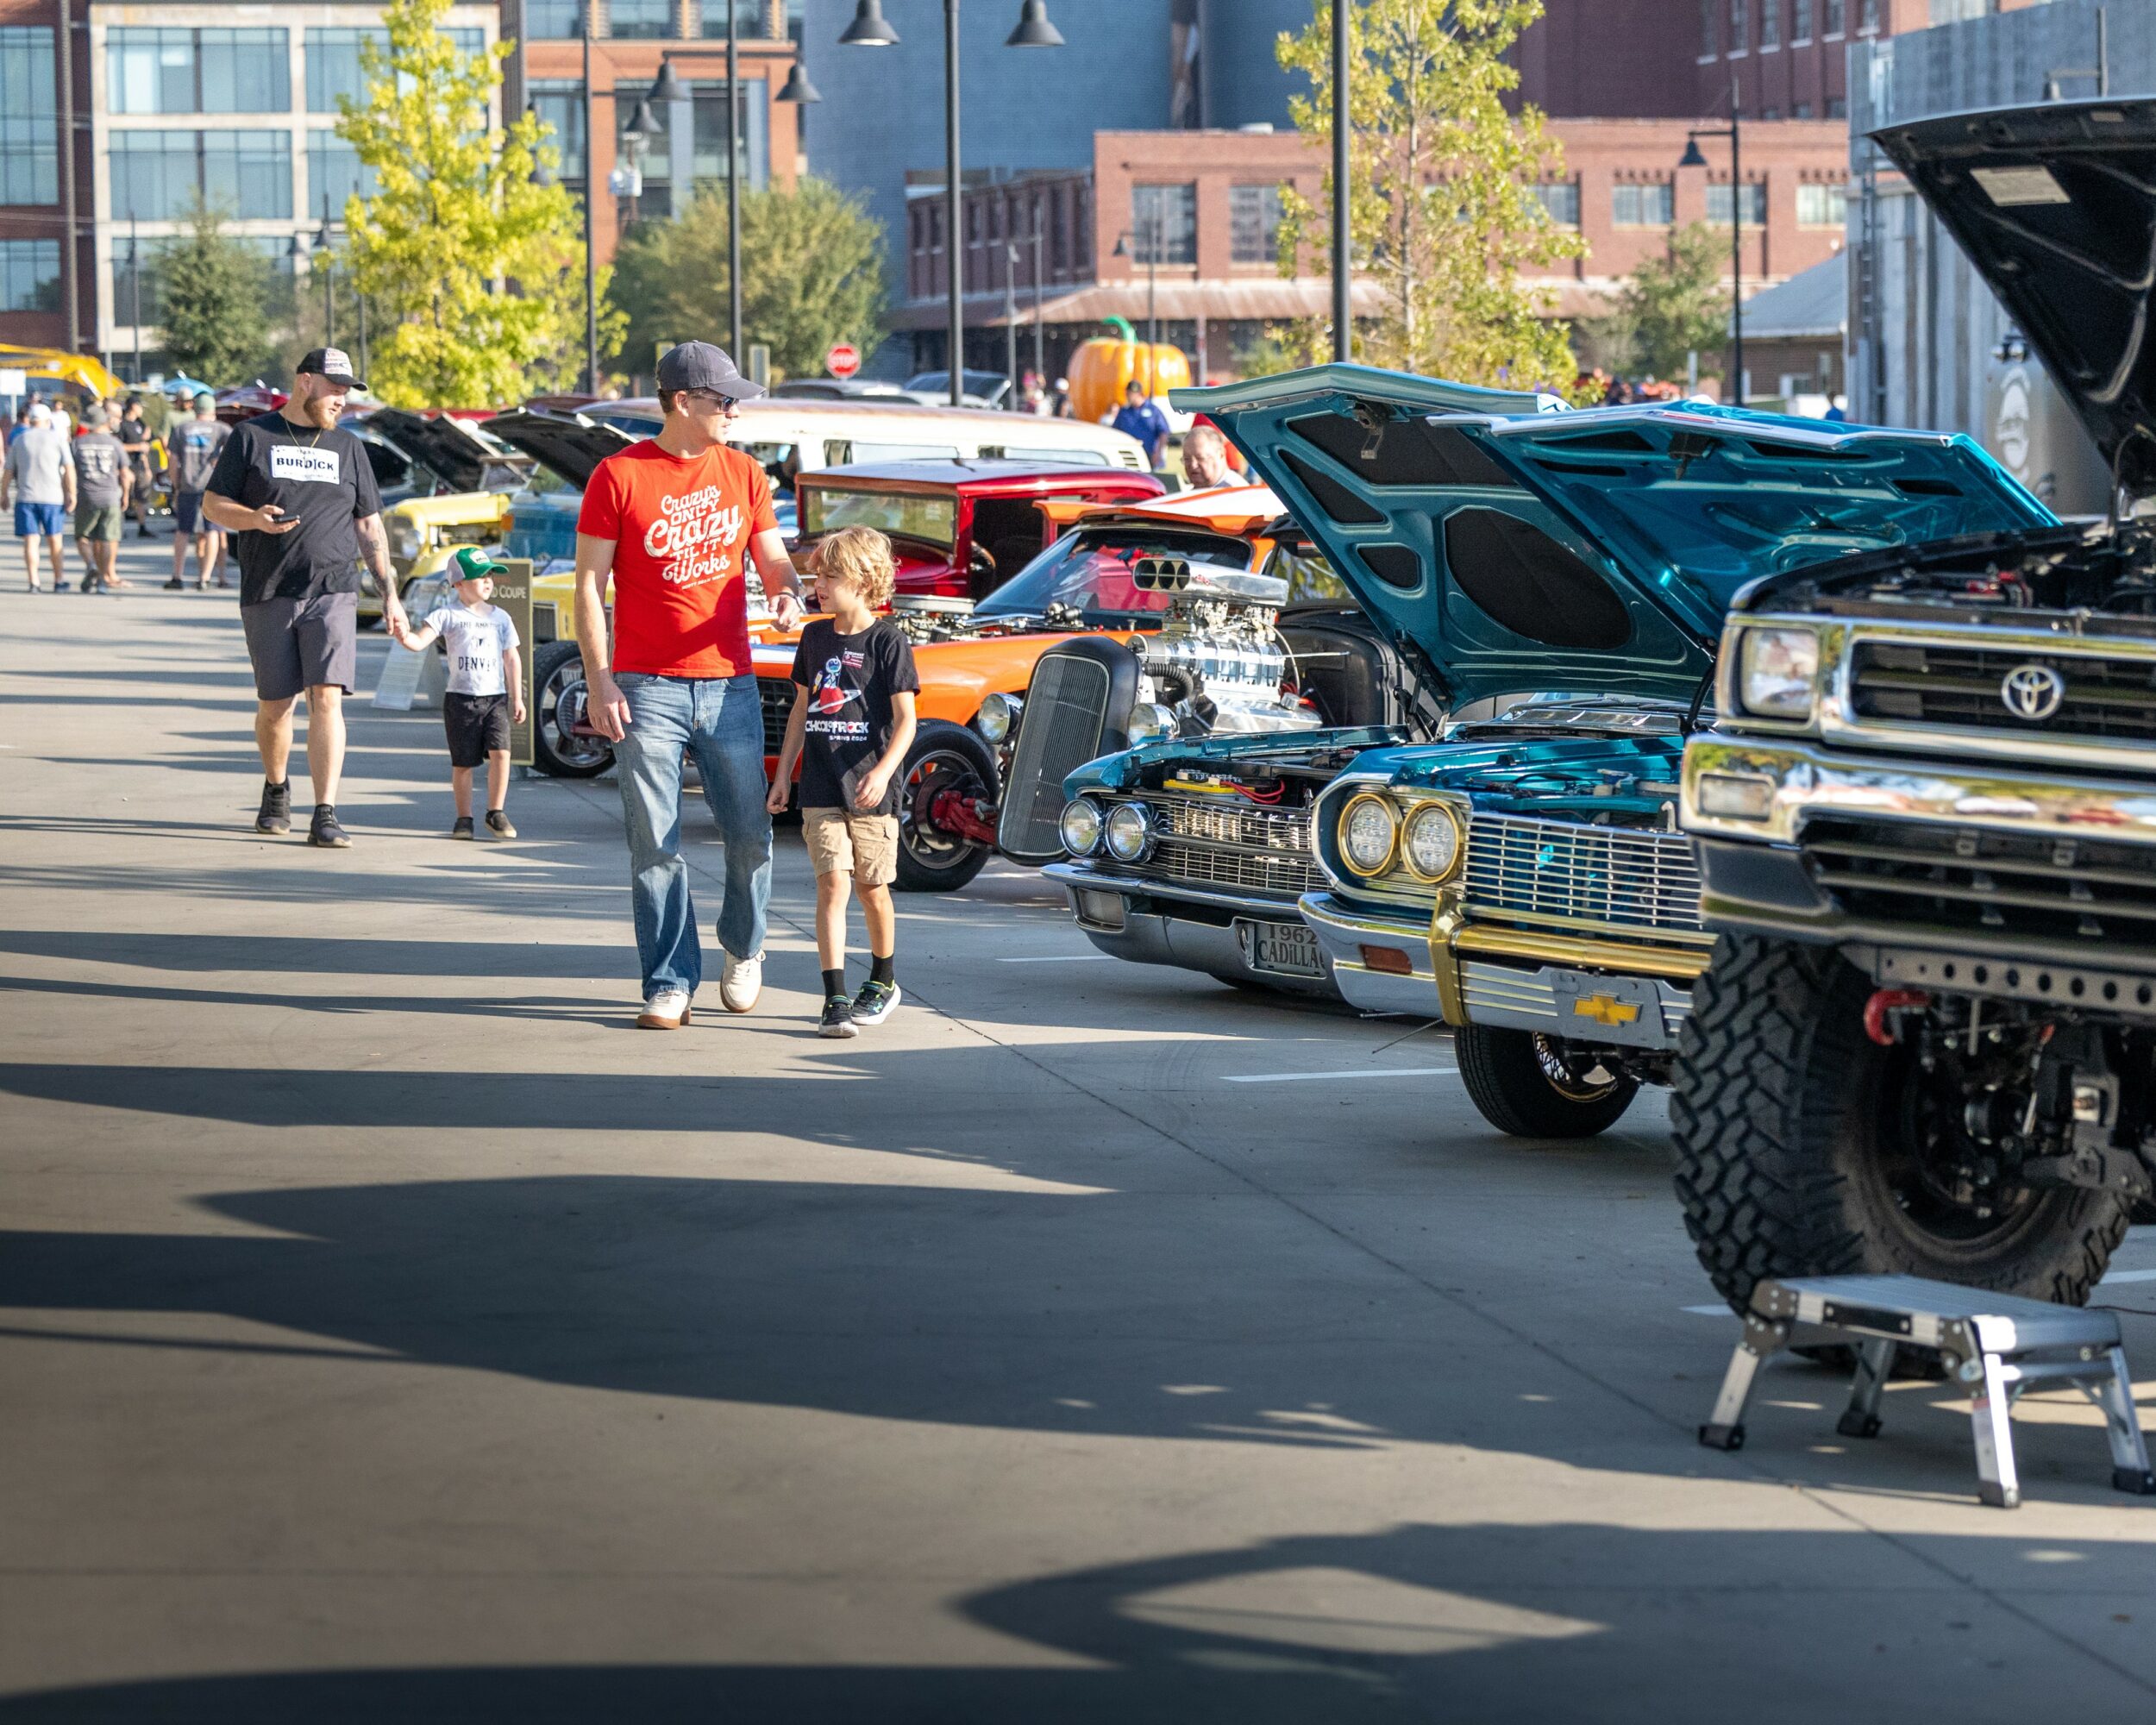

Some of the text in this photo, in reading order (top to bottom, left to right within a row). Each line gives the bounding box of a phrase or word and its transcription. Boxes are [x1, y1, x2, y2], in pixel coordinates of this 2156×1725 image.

[276, 457, 334, 470] BURDICK
[661, 485, 722, 515] Crazy's
[670, 498, 720, 526] ONLY
[643, 505, 743, 558] Crazy
[702, 536, 722, 554] IT
[661, 553, 731, 584] Works
[1269, 925, 1318, 944] 1962
